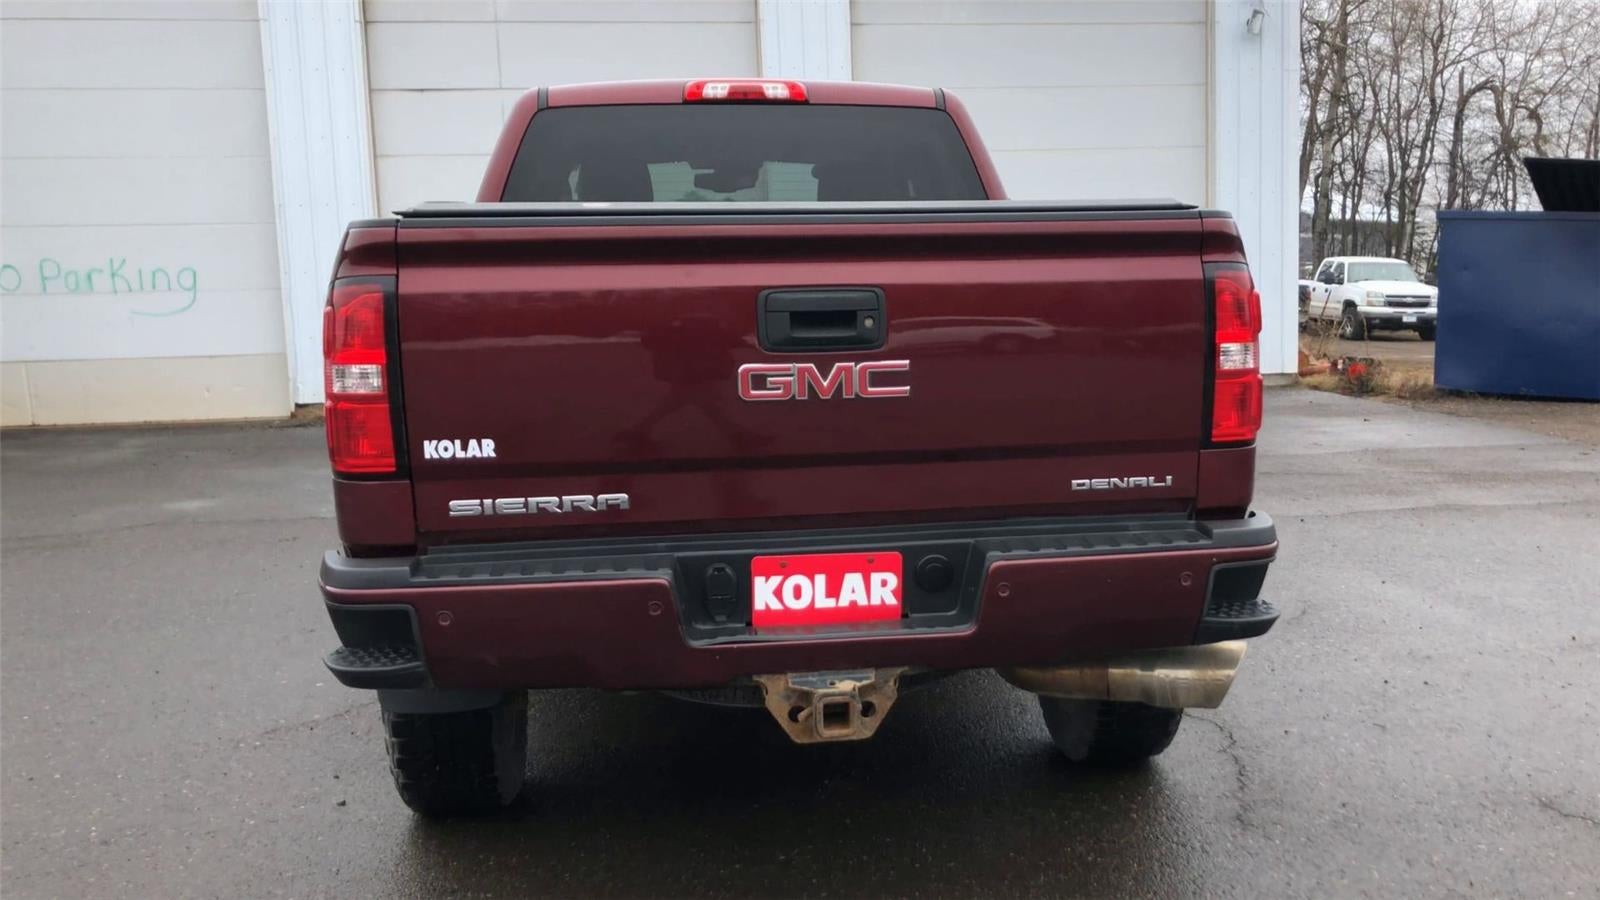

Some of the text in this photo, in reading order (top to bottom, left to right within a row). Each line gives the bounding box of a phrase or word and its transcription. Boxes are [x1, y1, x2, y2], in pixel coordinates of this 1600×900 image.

[738, 360, 911, 401] GMC
[423, 438, 496, 459] KOLAR
[1071, 475, 1173, 491] DENALI
[448, 493, 630, 517] SIERRA
[753, 571, 899, 611] KOLAR
